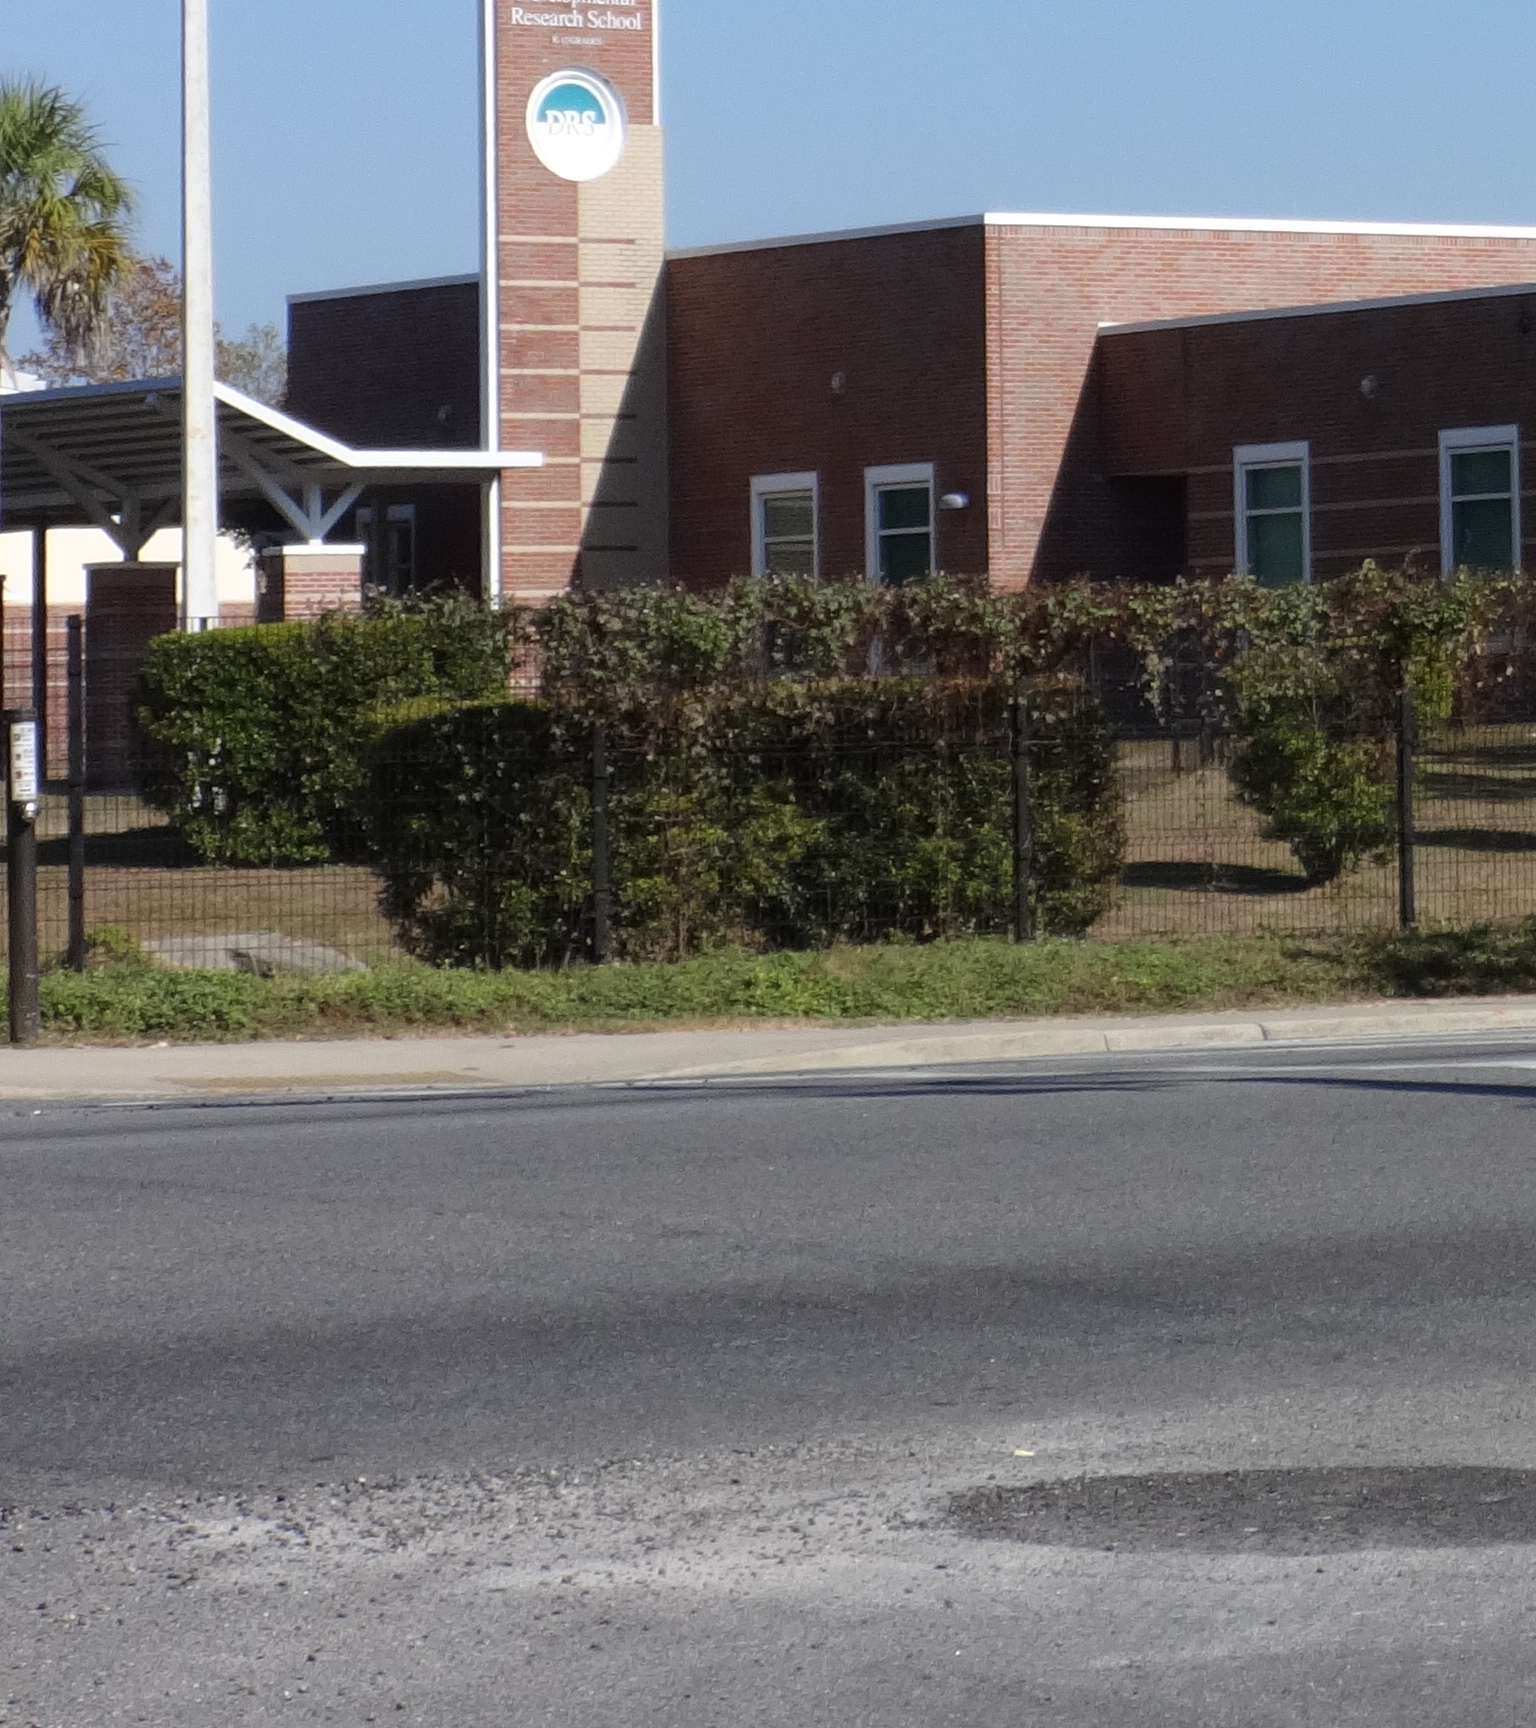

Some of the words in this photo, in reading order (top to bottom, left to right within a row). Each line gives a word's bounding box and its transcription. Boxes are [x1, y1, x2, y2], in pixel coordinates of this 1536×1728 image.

[511, 6, 583, 28] Research
[586, 10, 643, 31] School
[545, 109, 597, 137] DRS
